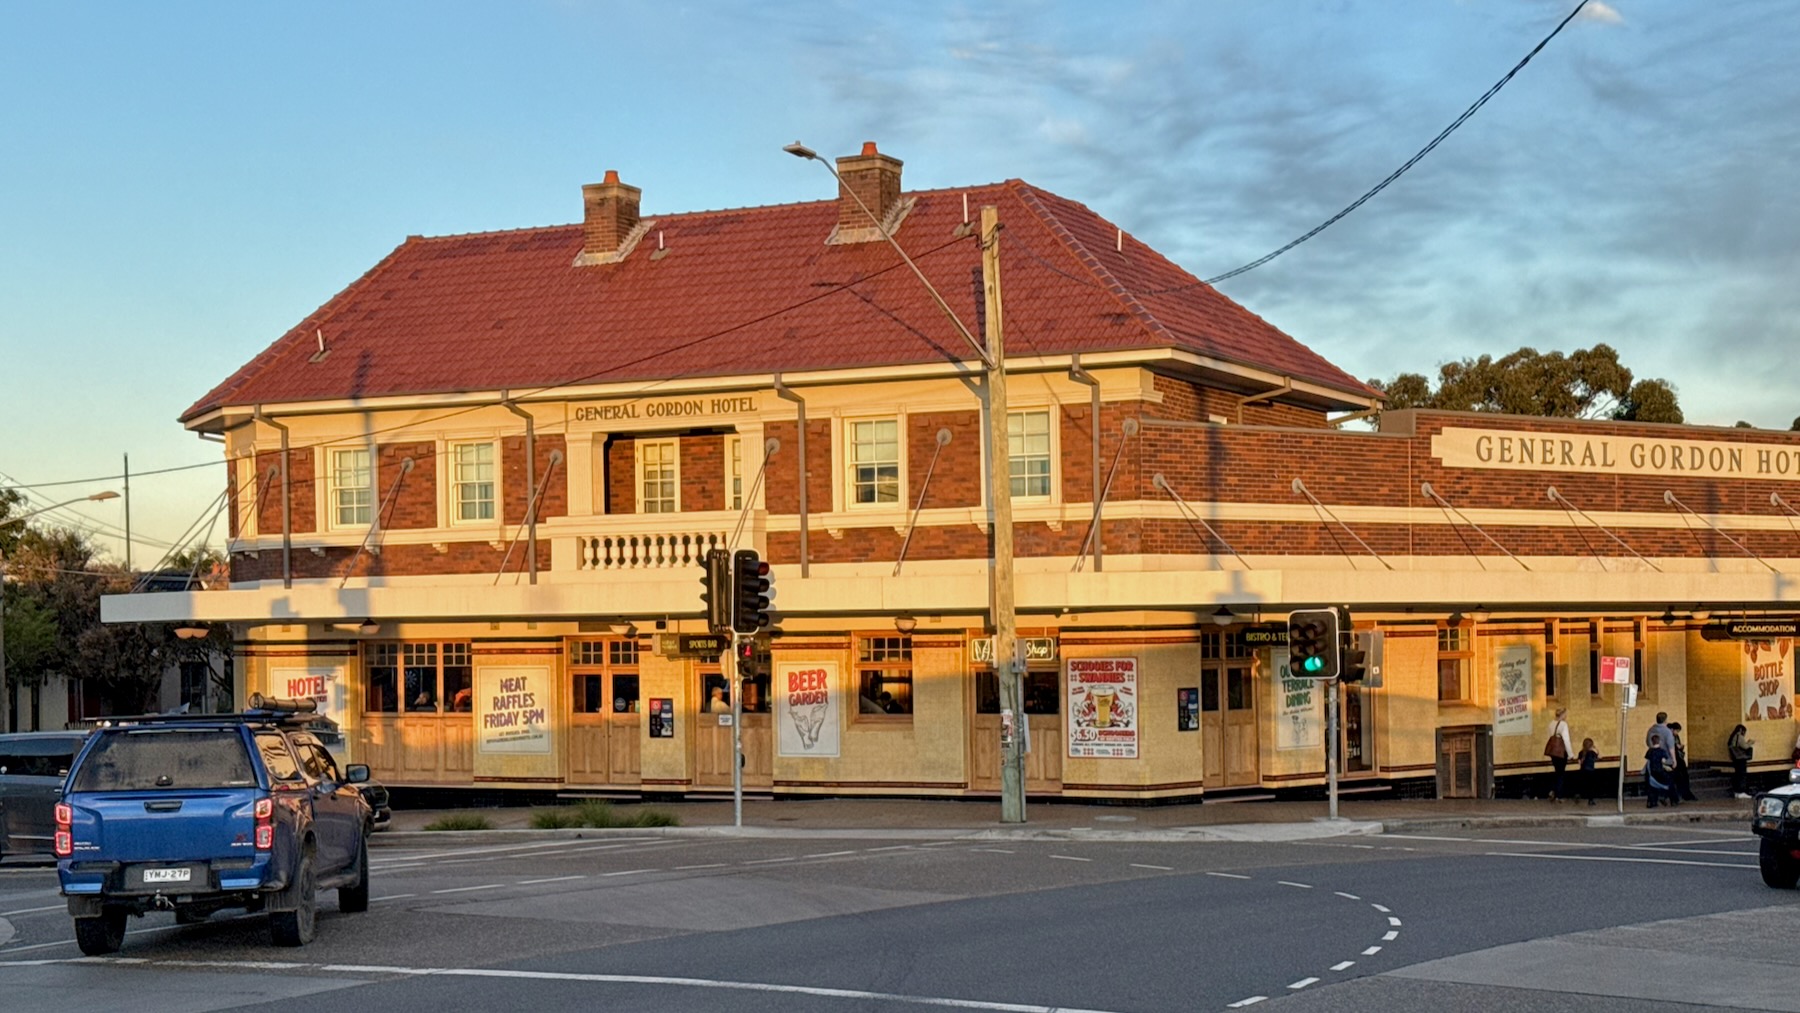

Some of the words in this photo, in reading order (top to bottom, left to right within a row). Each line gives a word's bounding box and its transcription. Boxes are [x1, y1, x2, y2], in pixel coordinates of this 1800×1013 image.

[575, 404, 640, 421] GENERAL
[646, 401, 703, 417] GORDON
[711, 397, 757, 413] HOTEL
[1475, 435, 1616, 467] GENERAL
[1630, 443, 1743, 472] GORDON
[1246, 632, 1271, 641] BISTRO
[1272, 632, 1277, 641] &
[1732, 625, 1796, 633] ACCOMMODATION
[689, 640, 707, 648] SPORTS
[708, 640, 717, 648] BAR
[1115, 661, 1133, 671] FOR
[1754, 661, 1783, 681] BOTTLE
[287, 675, 328, 697] HOTEL
[499, 676, 527, 693] MEAT
[788, 669, 827, 692] BEER
[1282, 679, 1314, 693] TERRACE
[1759, 680, 1779, 697] SHOP
[493, 693, 535, 711] RAFFLES
[788, 690, 828, 707] GARDEN
[1286, 691, 1311, 708] DINING
[484, 711, 519, 729] FRIDAY
[522, 708, 544, 725] 5PM
